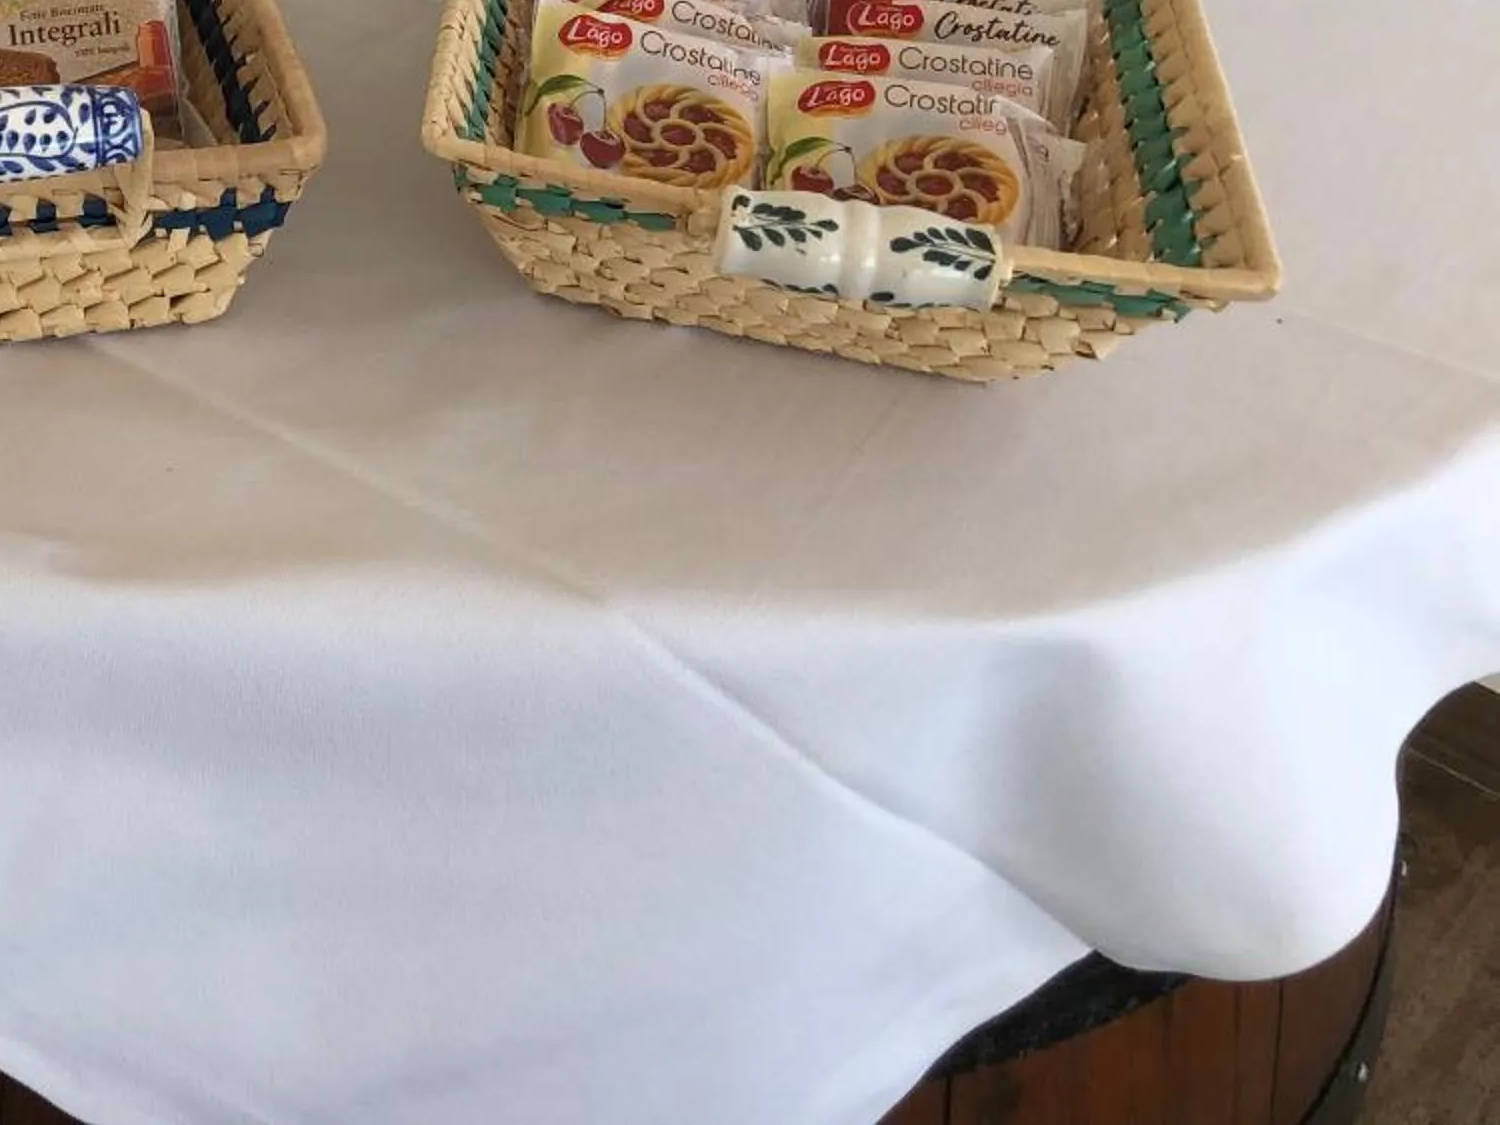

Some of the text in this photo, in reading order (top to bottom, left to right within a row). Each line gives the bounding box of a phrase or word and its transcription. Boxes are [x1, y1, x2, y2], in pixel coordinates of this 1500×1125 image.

[8, 11, 121, 47] Integrali
[567, 17, 623, 47] Lago
[857, 2, 1061, 47] Lago Crostatine
[824, 43, 1034, 81] Lago Crostatine
[806, 84, 866, 108] Lago
